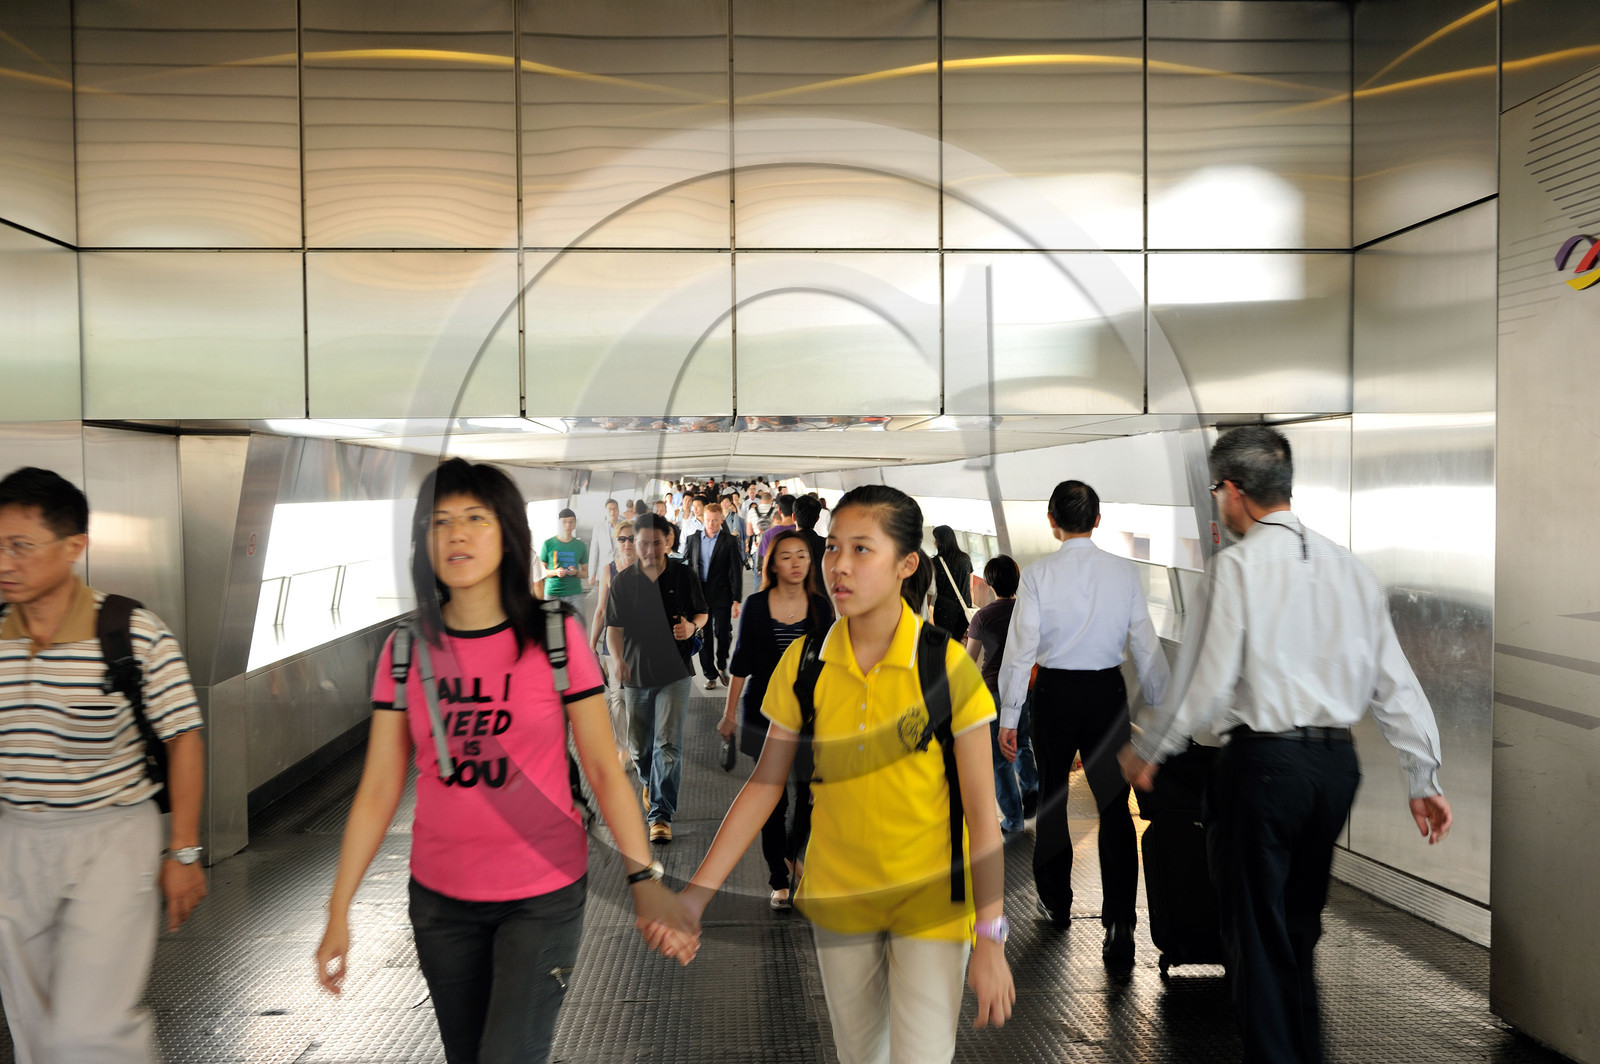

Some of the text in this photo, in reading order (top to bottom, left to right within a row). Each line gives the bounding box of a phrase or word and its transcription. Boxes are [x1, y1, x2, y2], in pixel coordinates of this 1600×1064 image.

[438, 673, 511, 704] ALL I
[463, 740, 481, 756] IS
